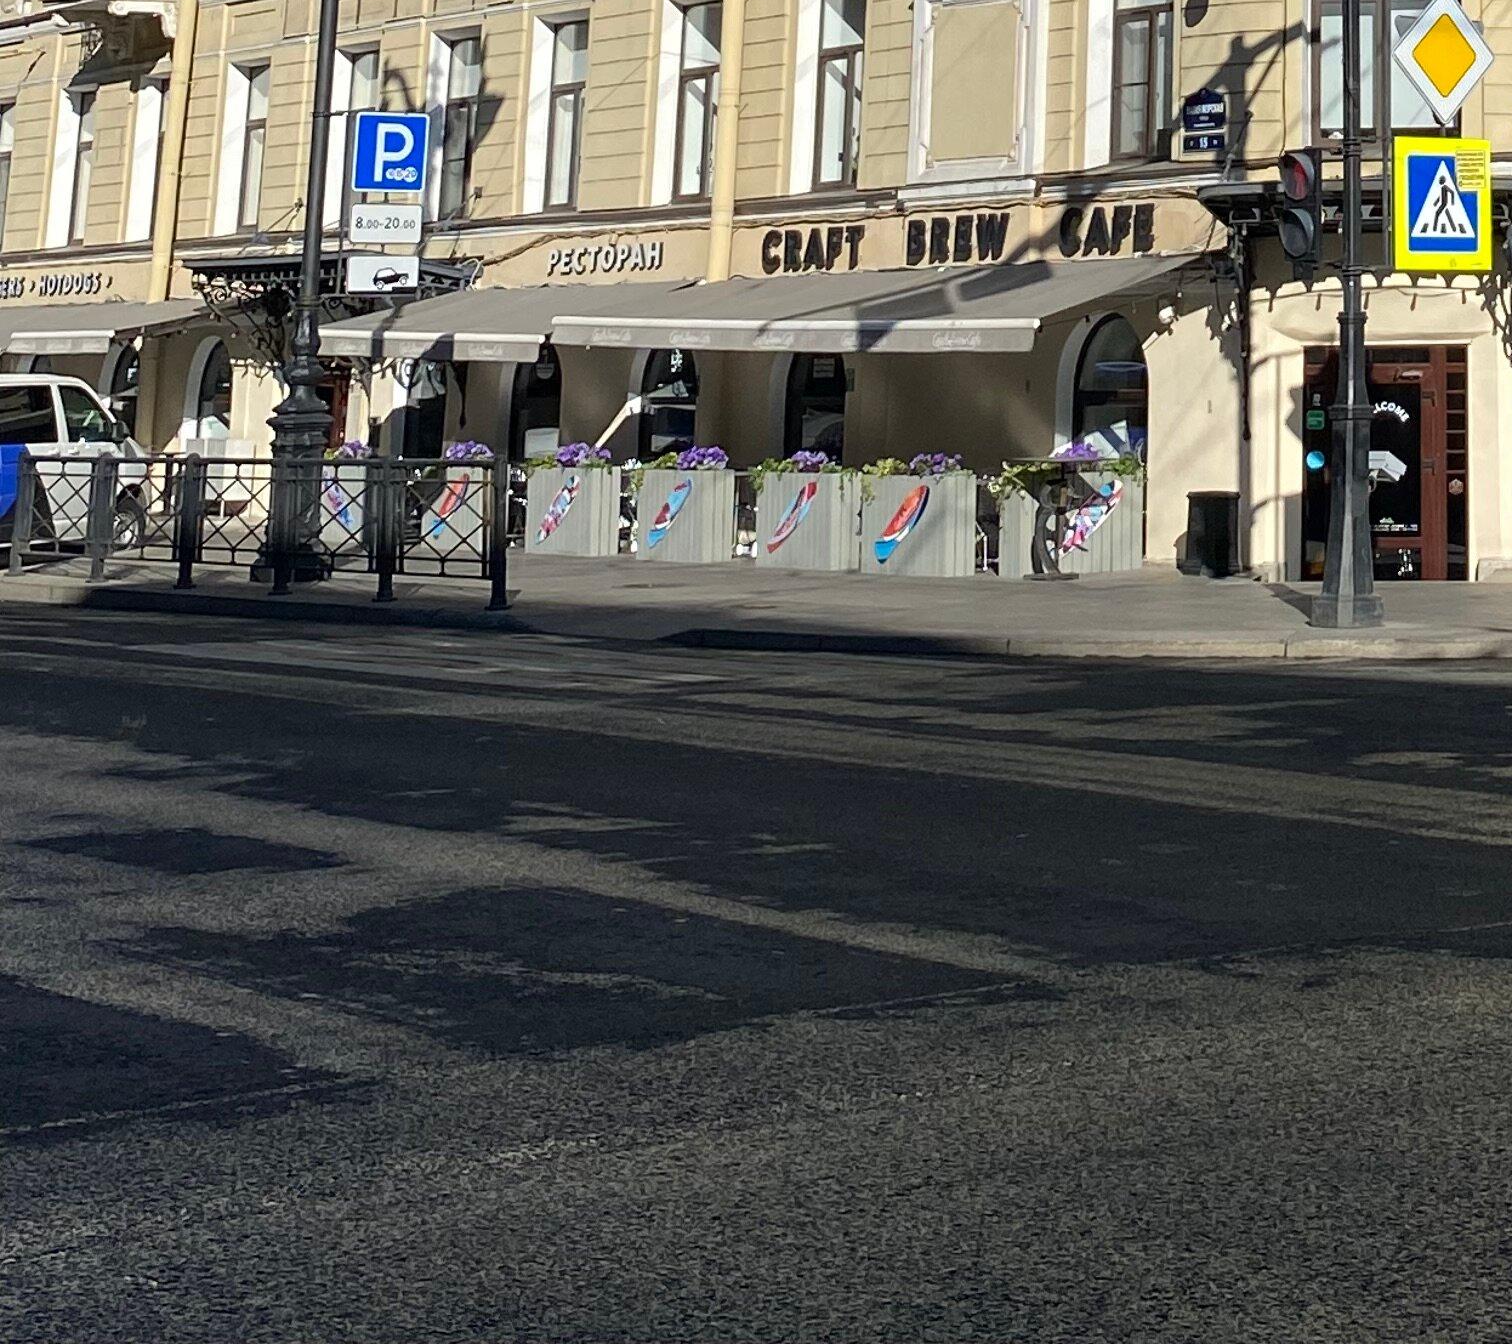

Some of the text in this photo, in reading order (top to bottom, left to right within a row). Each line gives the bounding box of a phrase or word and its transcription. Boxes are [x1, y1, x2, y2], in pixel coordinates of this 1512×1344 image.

[761, 202, 1155, 275] CRAFT BREW CAFE
[547, 241, 664, 277] РЕСТОРАН
[39, 272, 102, 297] HOTDOGS
[1373, 400, 1411, 423] LCOME
